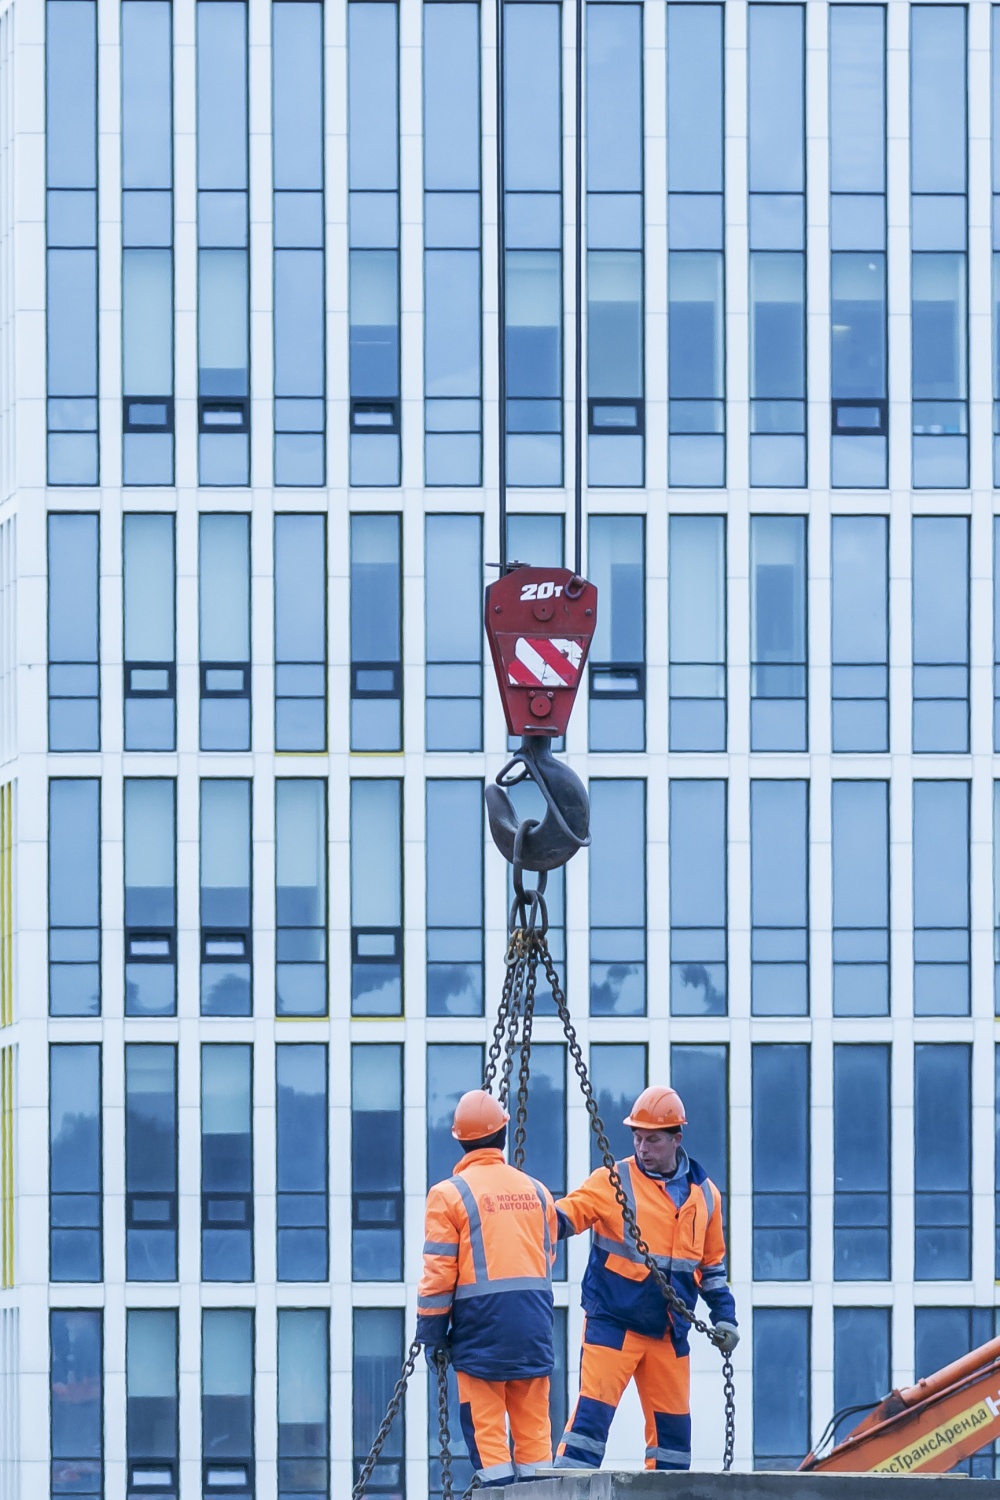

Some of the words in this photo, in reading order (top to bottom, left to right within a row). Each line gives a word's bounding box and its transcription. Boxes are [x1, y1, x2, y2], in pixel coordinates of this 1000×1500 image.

[497, 1193, 537, 1202] МОСКВА
[500, 1202, 540, 1211] АВТОДОР
[873, 1408, 988, 1473] сТрансАренда
